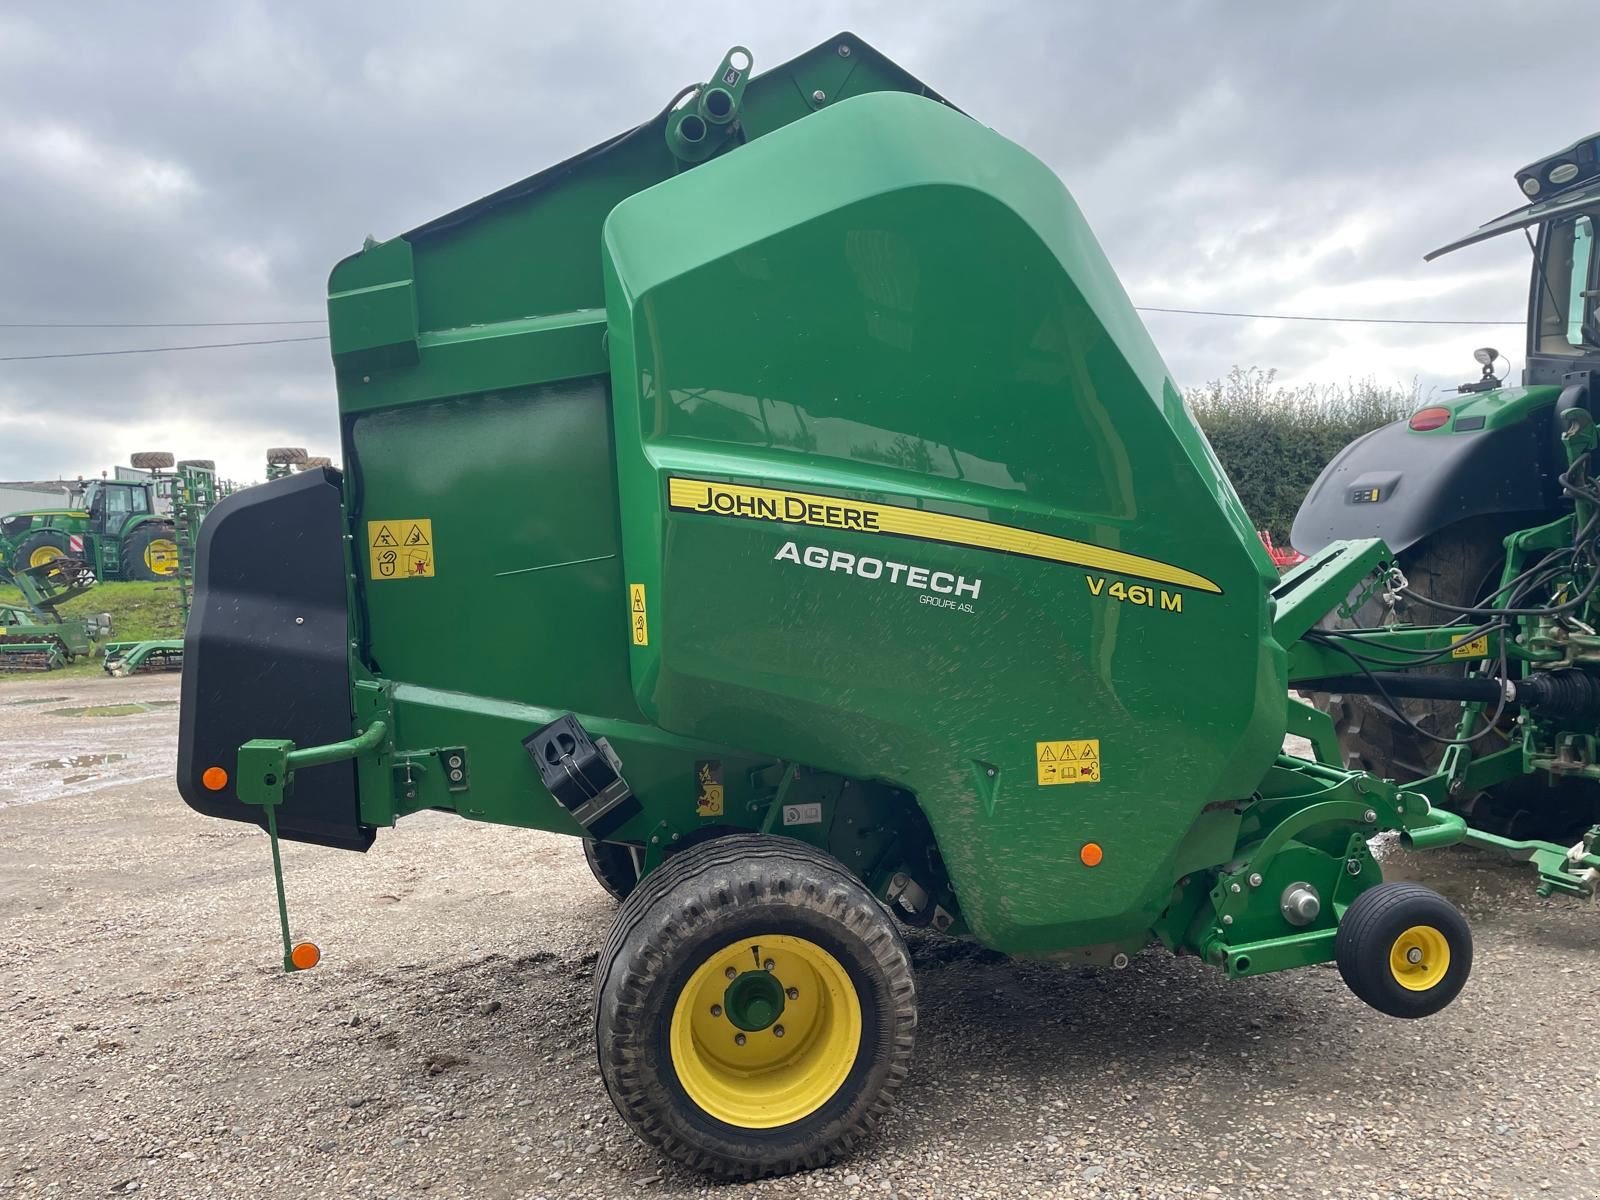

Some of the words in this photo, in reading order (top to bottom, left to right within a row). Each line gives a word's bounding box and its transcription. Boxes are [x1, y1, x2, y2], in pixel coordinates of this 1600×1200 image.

[697, 486, 778, 518] JOHN
[783, 496, 880, 531] DEERE
[774, 541, 982, 599] AGROTECH
[919, 594, 956, 611] GROUPE
[957, 601, 976, 614] ASL
[1160, 590, 1184, 613] M
